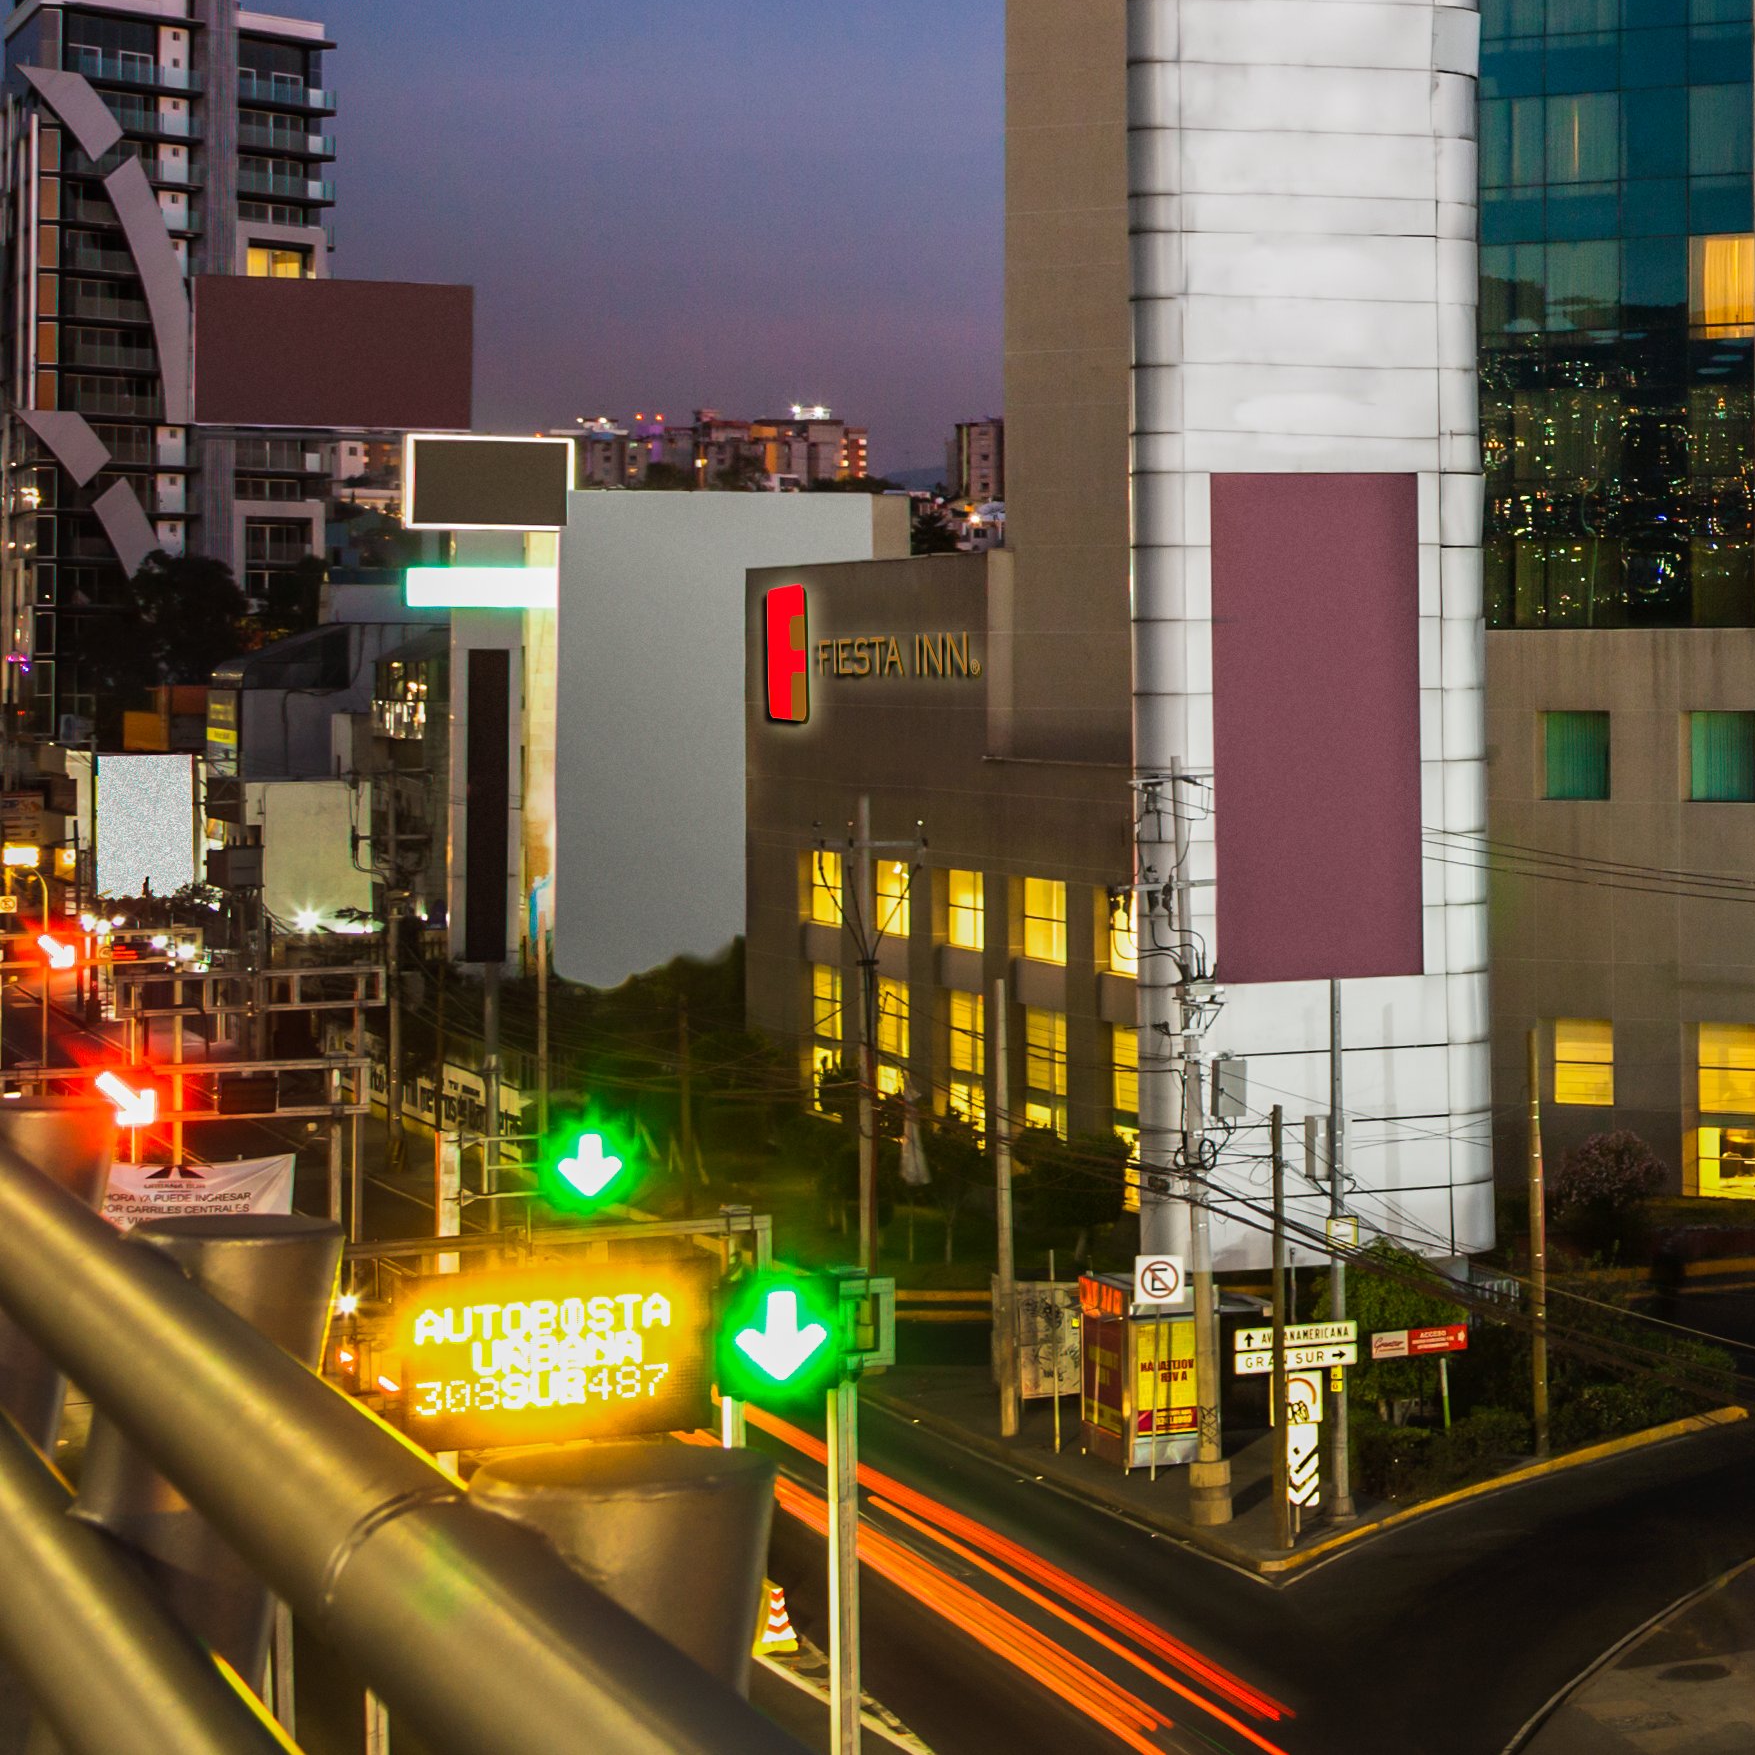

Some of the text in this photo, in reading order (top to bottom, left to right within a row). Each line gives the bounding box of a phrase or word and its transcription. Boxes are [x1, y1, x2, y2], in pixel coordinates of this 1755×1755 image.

[818, 636, 904, 677] FIESTA
[153, 1193, 193, 1203] PUEDE
[194, 1192, 252, 1203] INGRESAR
[126, 1205, 182, 1214] CARRILES
[184, 1204, 250, 1214] CENTRALES
[1284, 1326, 1350, 1341] ANAMERICANA
[1295, 1351, 1324, 1364] SUR
